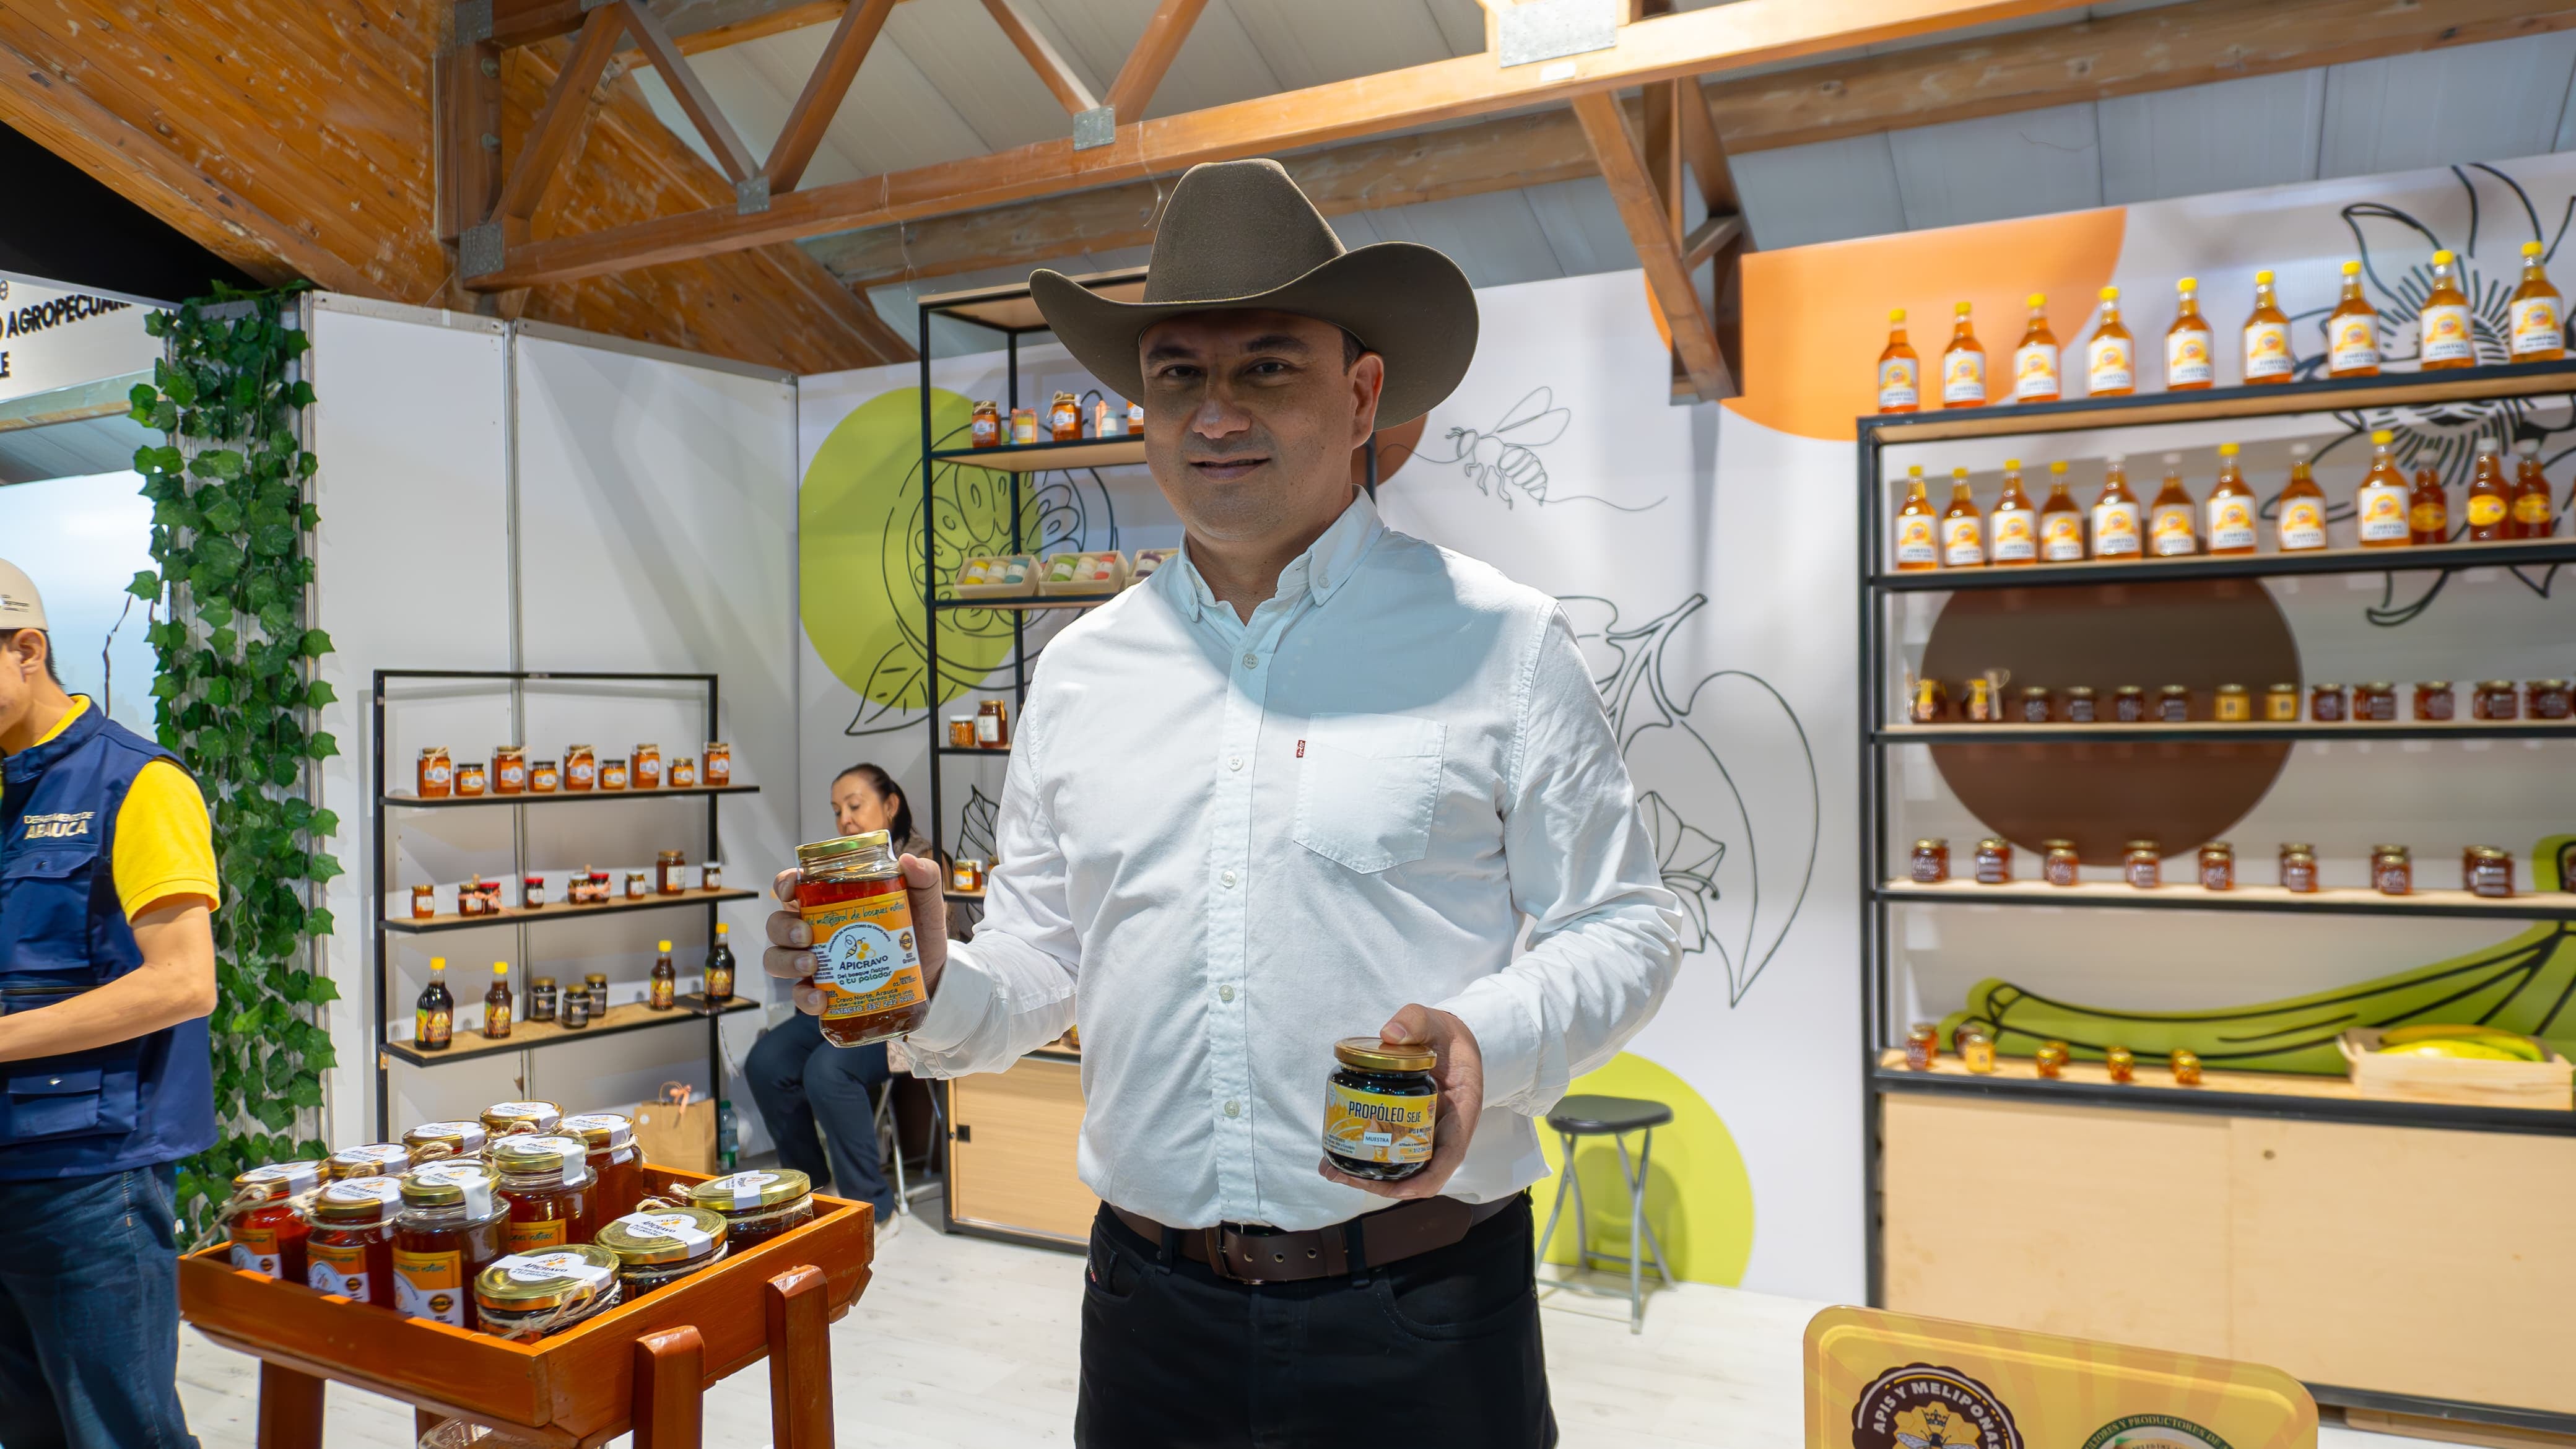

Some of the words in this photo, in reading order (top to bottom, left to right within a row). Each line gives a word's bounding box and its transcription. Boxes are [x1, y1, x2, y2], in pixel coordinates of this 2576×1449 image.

[6, 294, 132, 338] AGROPECUA
[839, 955, 889, 970] APICRAVO
[859, 971, 892, 983] paladar
[1348, 1101, 1404, 1123] PROPÓLEO
[1365, 1135, 1390, 1144] MUESTRA
[521, 1263, 568, 1273] APICRAVO
[1873, 1395, 1897, 1434] APIS
[1894, 1386, 1907, 1399] Y
[1911, 1382, 2001, 1449] MELIPONAS
[2128, 1416, 2205, 1437] PRODUCTORES
